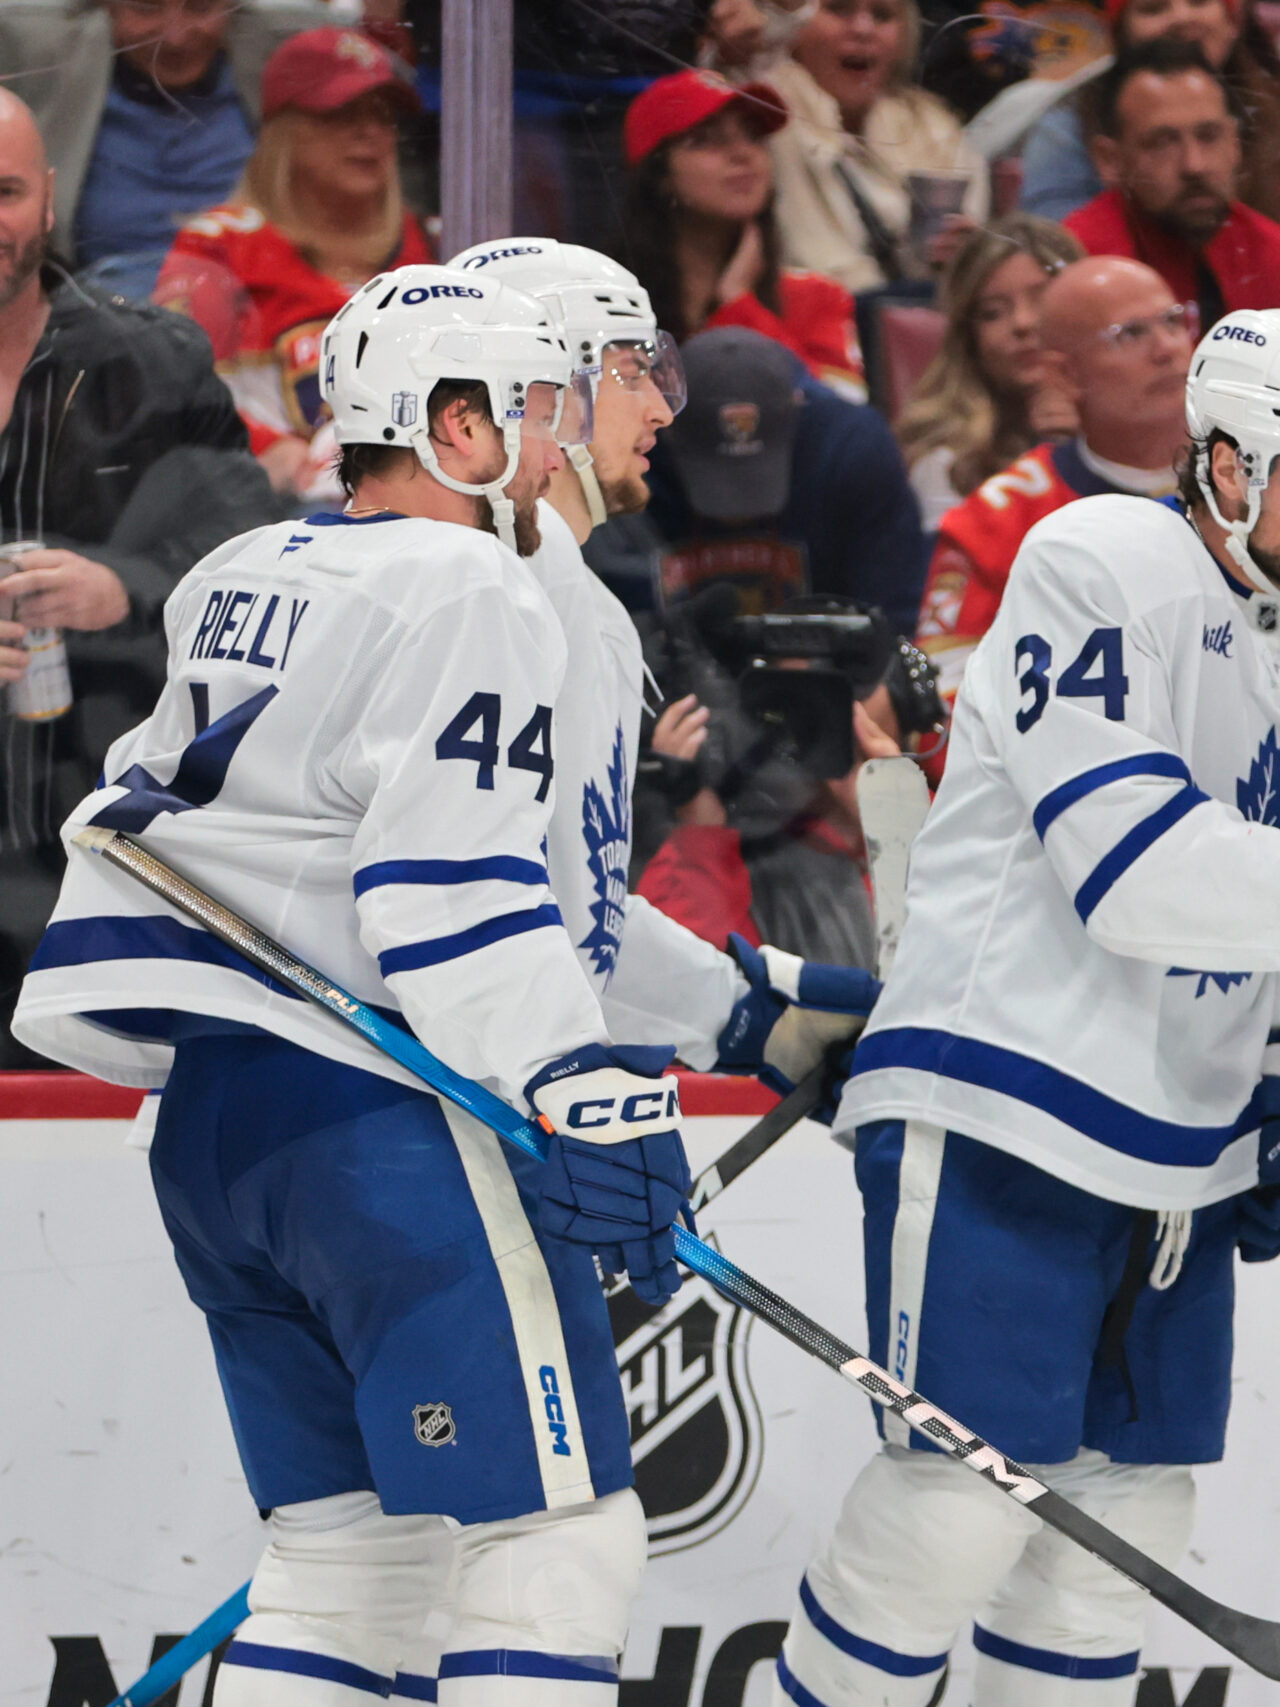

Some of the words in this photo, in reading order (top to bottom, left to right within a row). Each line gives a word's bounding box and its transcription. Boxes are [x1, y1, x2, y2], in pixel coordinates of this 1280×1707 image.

[401, 284, 484, 306] OREO
[463, 246, 543, 270] OREO
[1212, 325, 1267, 347] OREO
[189, 589, 310, 672] RIELLY
[1014, 626, 1129, 735] 34
[435, 691, 555, 803] 44
[550, 1061, 580, 1080] RIELLY
[538, 1364, 572, 1457] CCM
[619, 1325, 706, 1427] HL
[423, 1411, 447, 1438] NHL
[839, 1355, 1050, 1505] CCM
